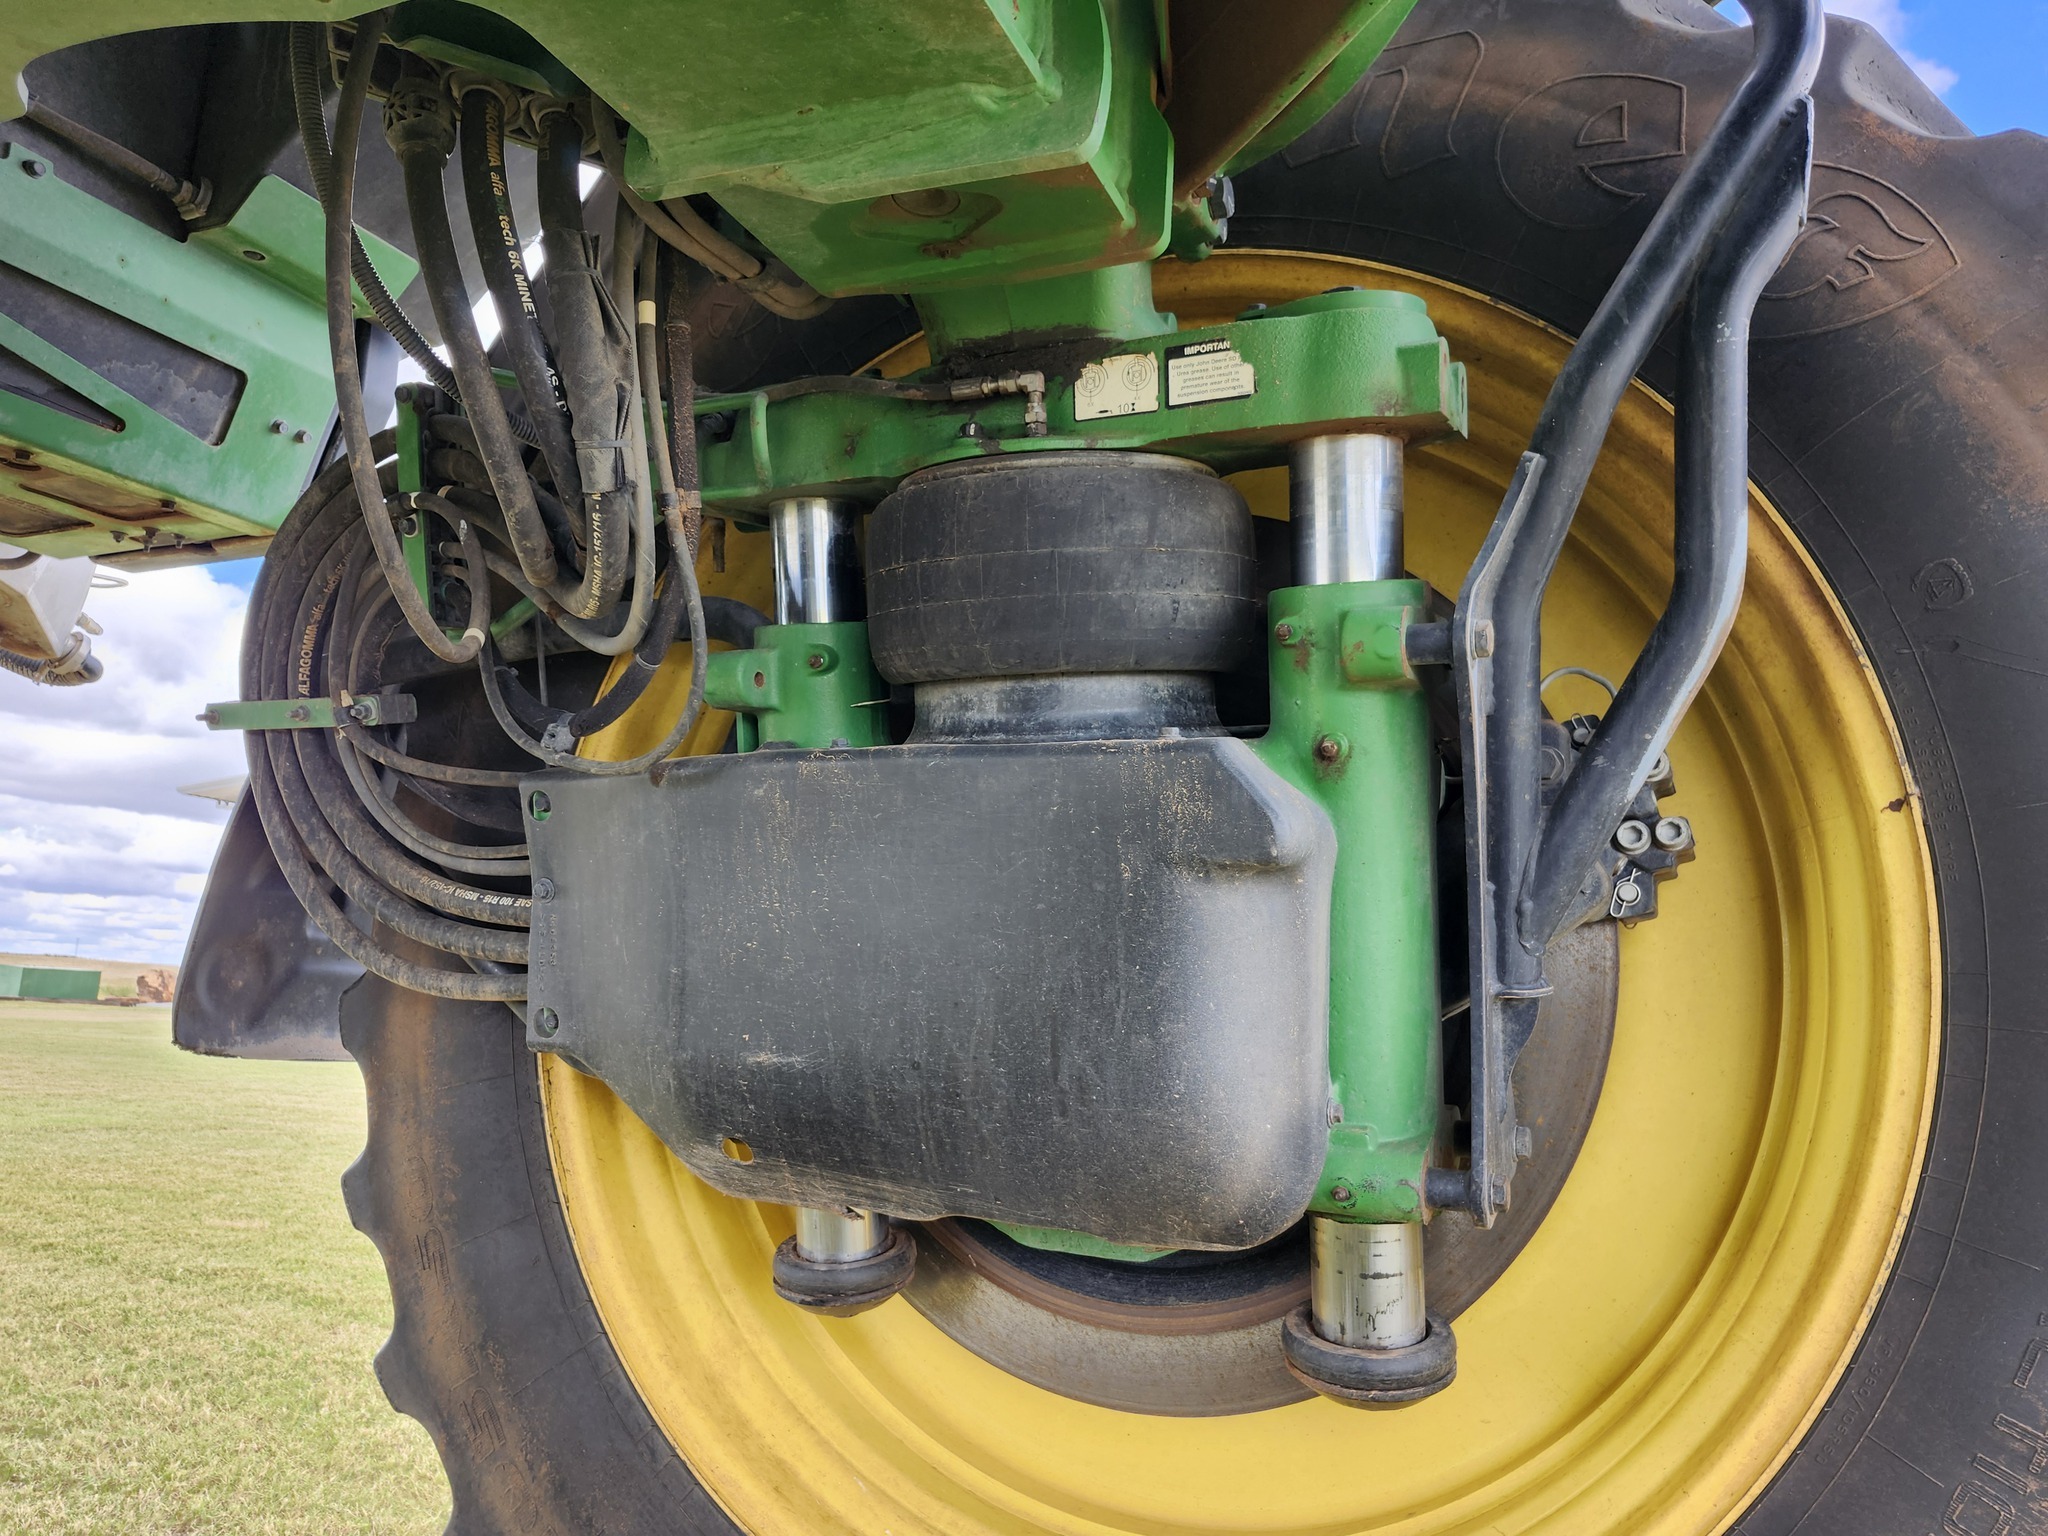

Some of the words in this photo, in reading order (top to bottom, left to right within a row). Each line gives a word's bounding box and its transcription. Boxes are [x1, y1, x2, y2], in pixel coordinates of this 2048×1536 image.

[508, 250, 522, 270] 6K
[1184, 341, 1230, 355] IMPORTAN
[1183, 362, 1194, 370] only
[1182, 376, 1205, 384] greases
[1180, 382, 1208, 391] premature
[1177, 389, 1208, 398] suspension
[1118, 404, 1130, 413] 10
[591, 569, 602, 597] MSHA
[298, 623, 320, 697] ALFAGOMMA
[1904, 706, 1919, 727] BE
[1913, 738, 1935, 780] USED
[1926, 726, 1960, 813] TUBELESS
[419, 876, 455, 895] IC-152/16
[454, 889, 481, 901] MSHA
[483, 895, 498, 905] R15
[499, 897, 514, 906] 100
